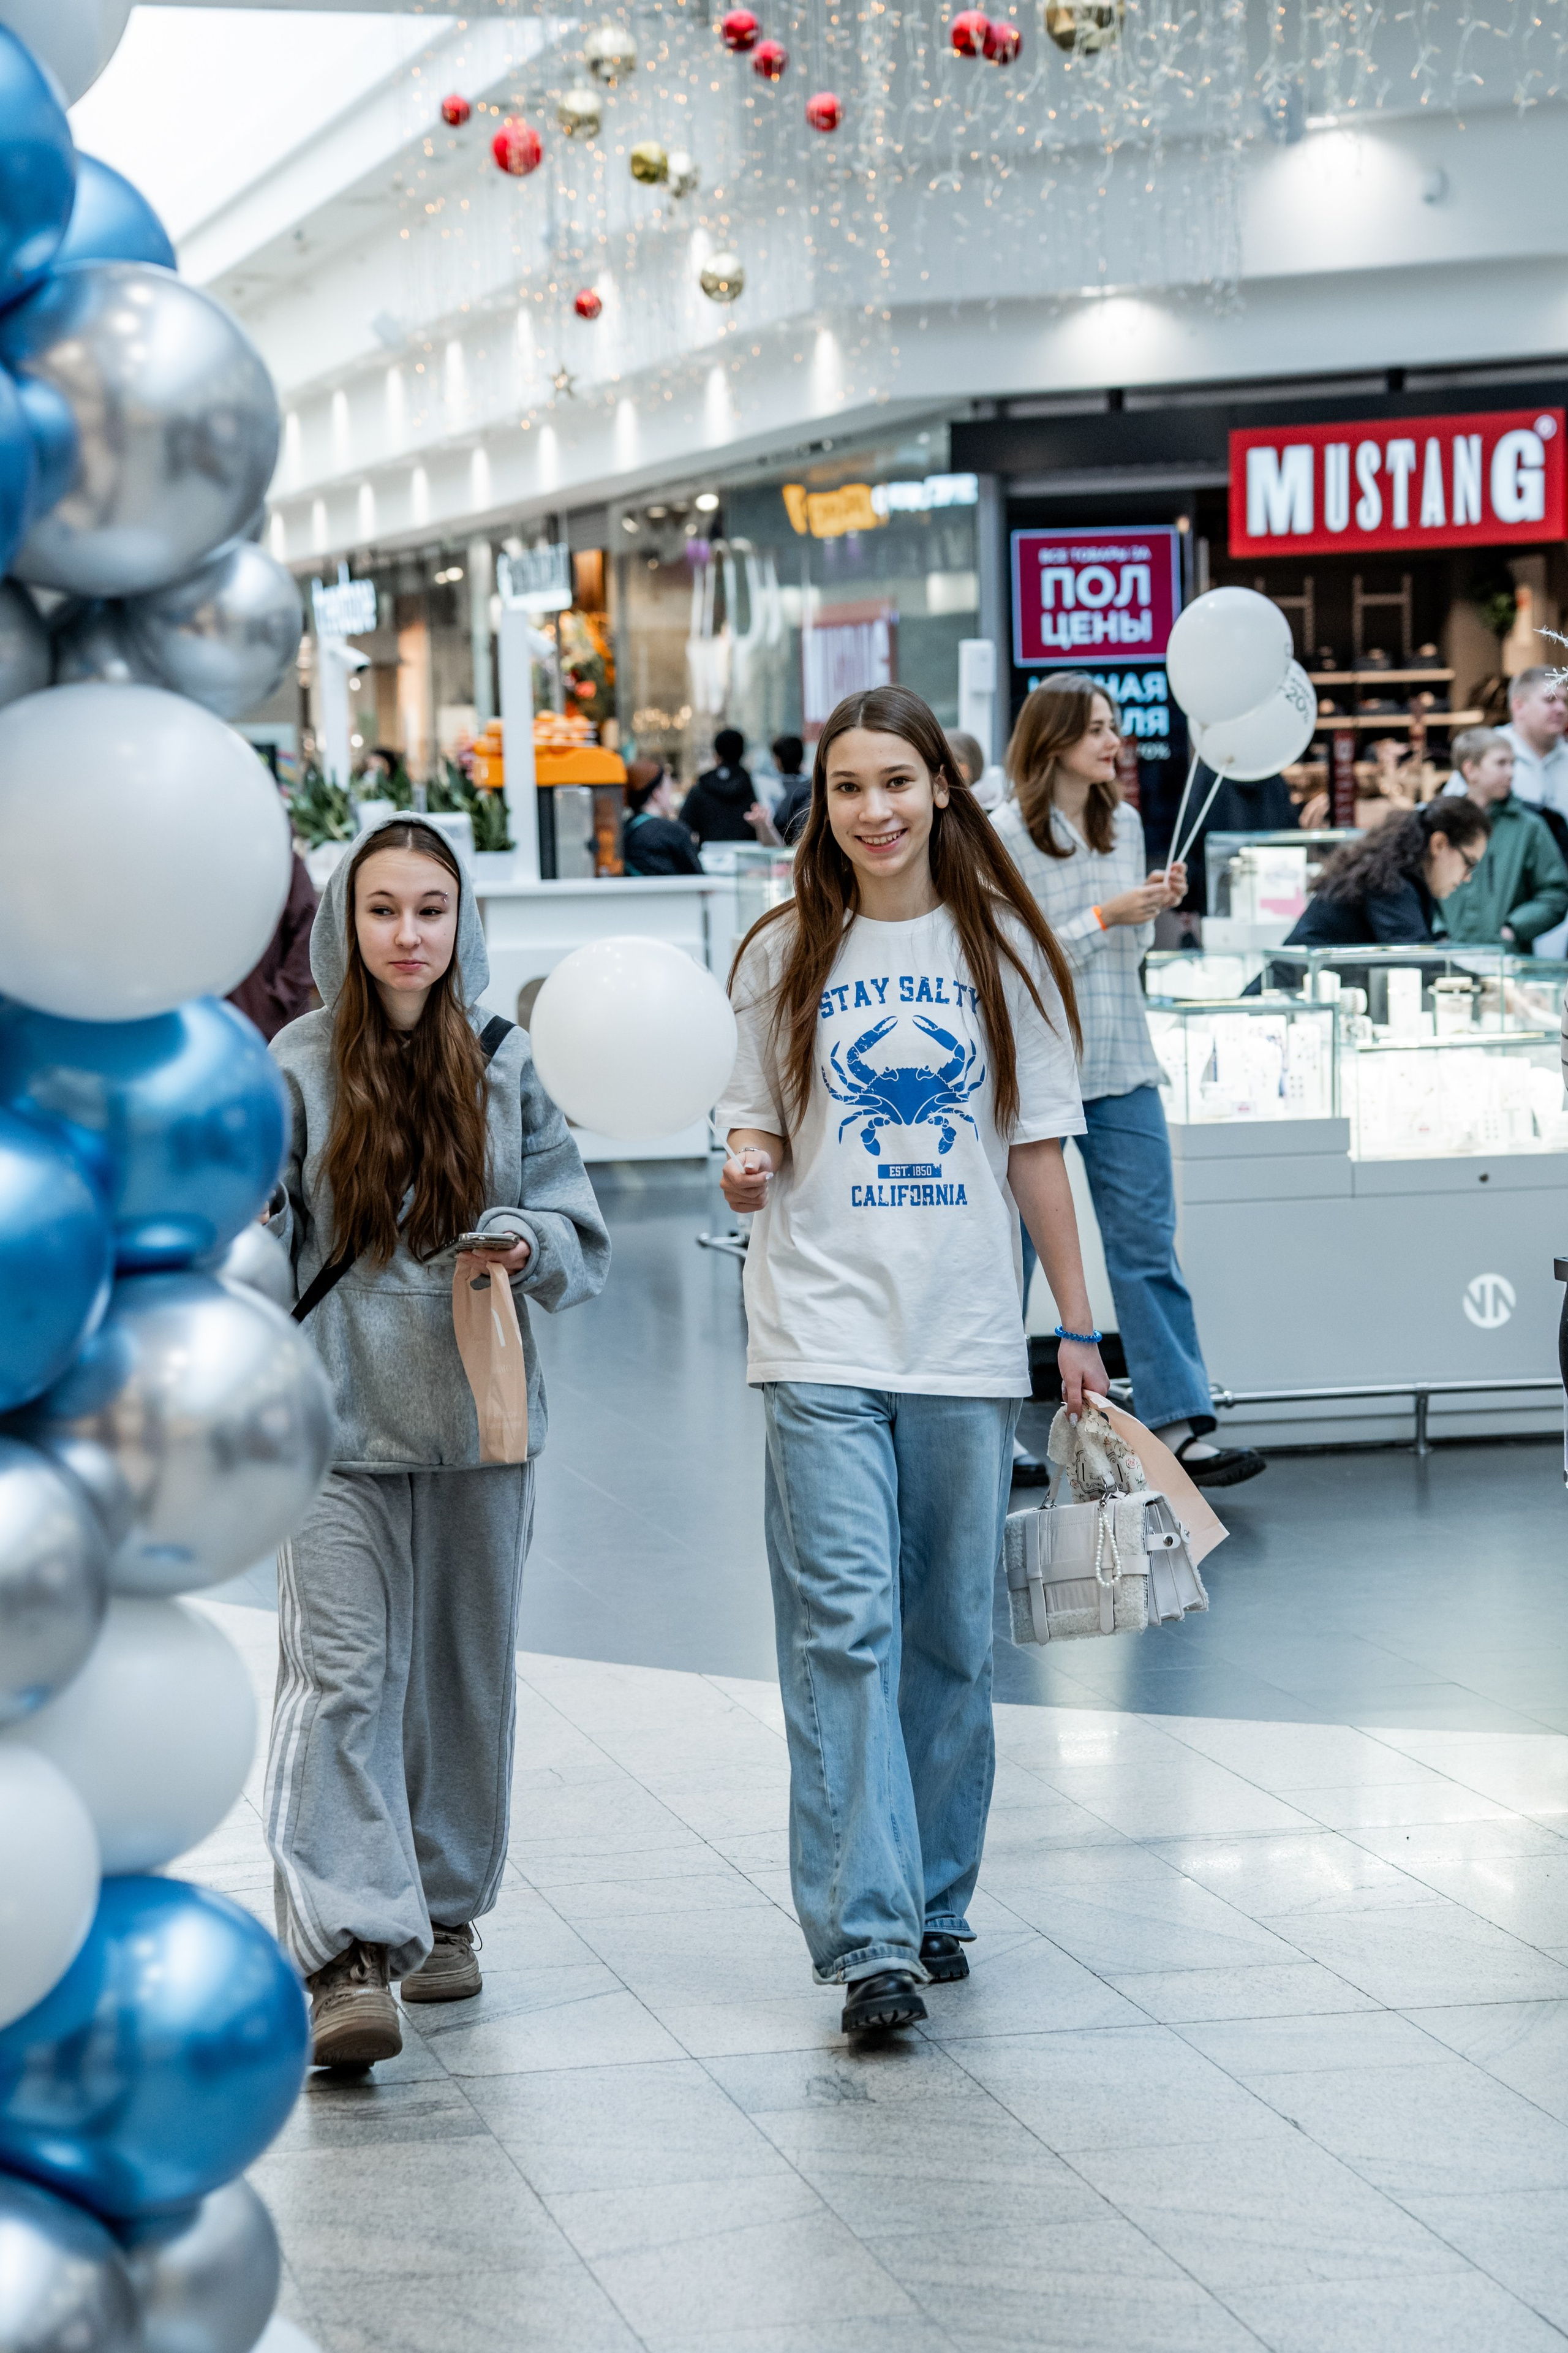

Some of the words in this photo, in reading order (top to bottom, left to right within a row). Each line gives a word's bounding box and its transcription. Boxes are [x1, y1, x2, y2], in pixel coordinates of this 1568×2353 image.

[1246, 428, 1546, 538] MUSTANG
[1041, 564, 1151, 610] ПОЛ
[1041, 608, 1153, 651] ЦЕНЫ
[820, 976, 889, 1019] STAY
[899, 976, 981, 1014] SALTY
[889, 1166, 910, 1177] EST.
[913, 1165, 932, 1176] 1850
[852, 1184, 968, 1207] CALIFORNIA
